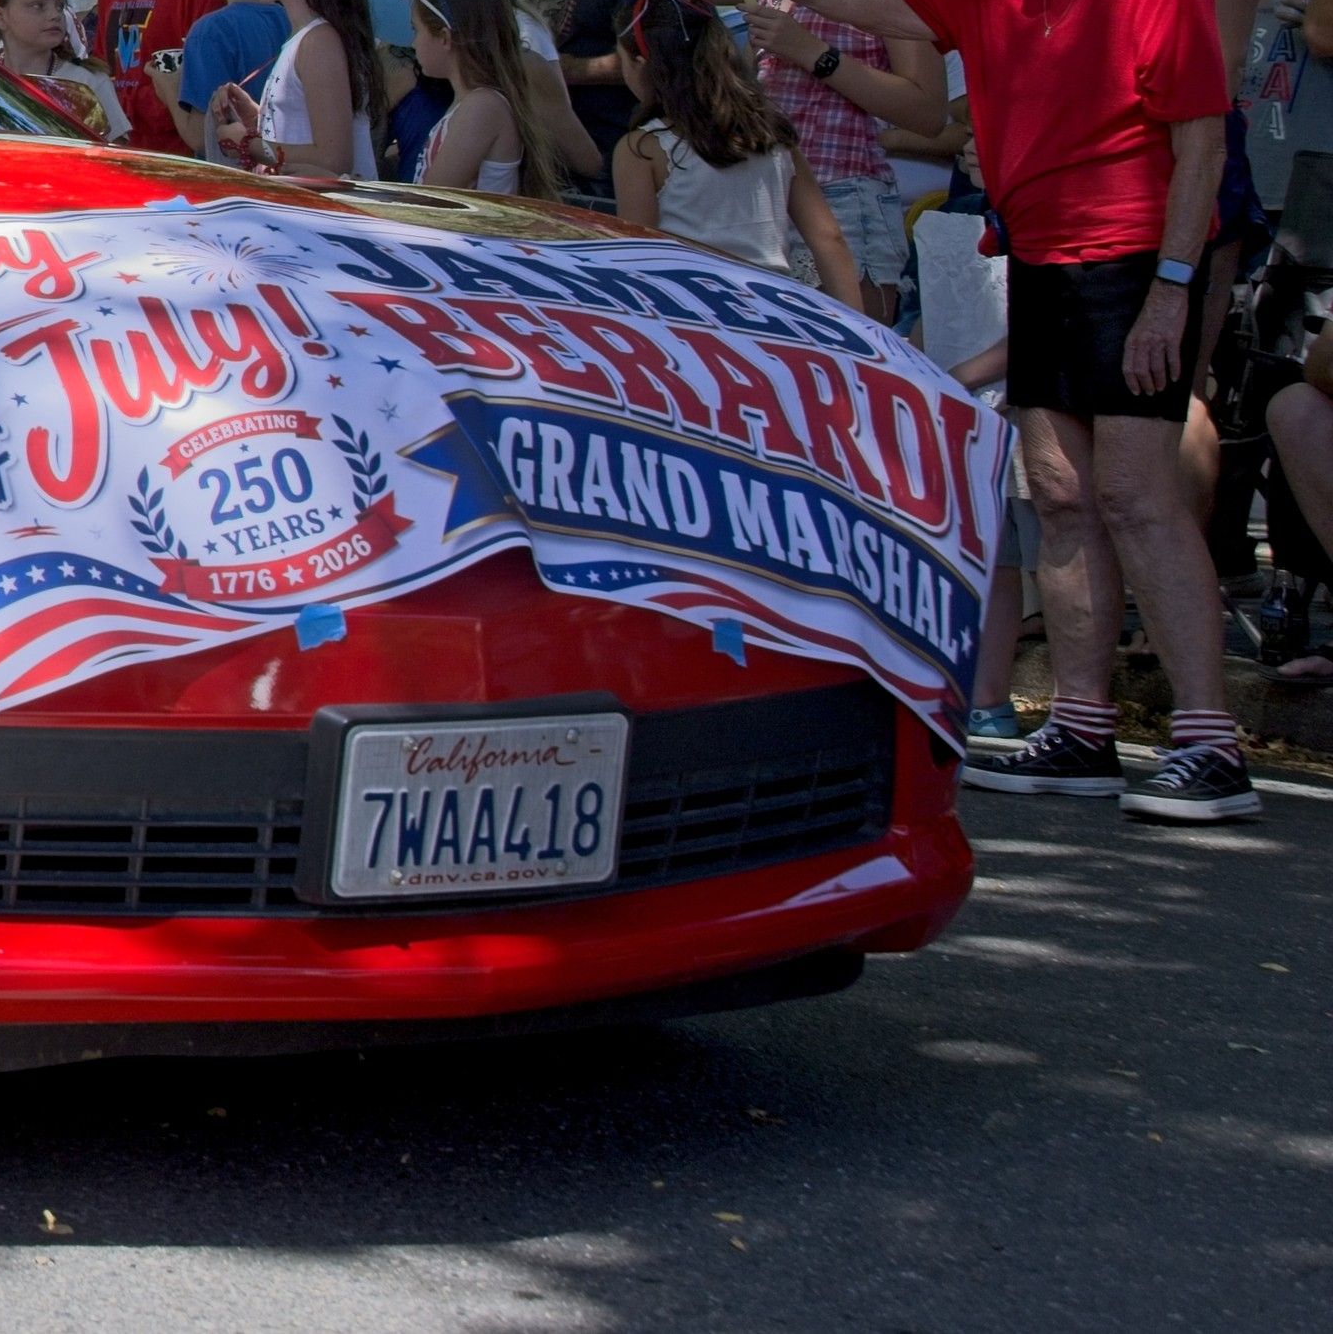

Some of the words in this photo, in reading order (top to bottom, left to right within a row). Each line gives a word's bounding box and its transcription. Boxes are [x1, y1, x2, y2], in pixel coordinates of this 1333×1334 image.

[319, 233, 879, 360] JAMES
[178, 415, 298, 458] CELEBRATING
[333, 291, 985, 564] BERARDI
[199, 448, 313, 526] 250
[209, 569, 276, 594] 1776
[308, 534, 371, 578] 2026
[221, 508, 326, 556] YEARS
[497, 416, 711, 539] GRAND
[719, 470, 961, 656] MARSHAL
[407, 737, 575, 783] California
[364, 782, 604, 868] 7WAA418
[408, 866, 549, 885] dmv.ca.gov
